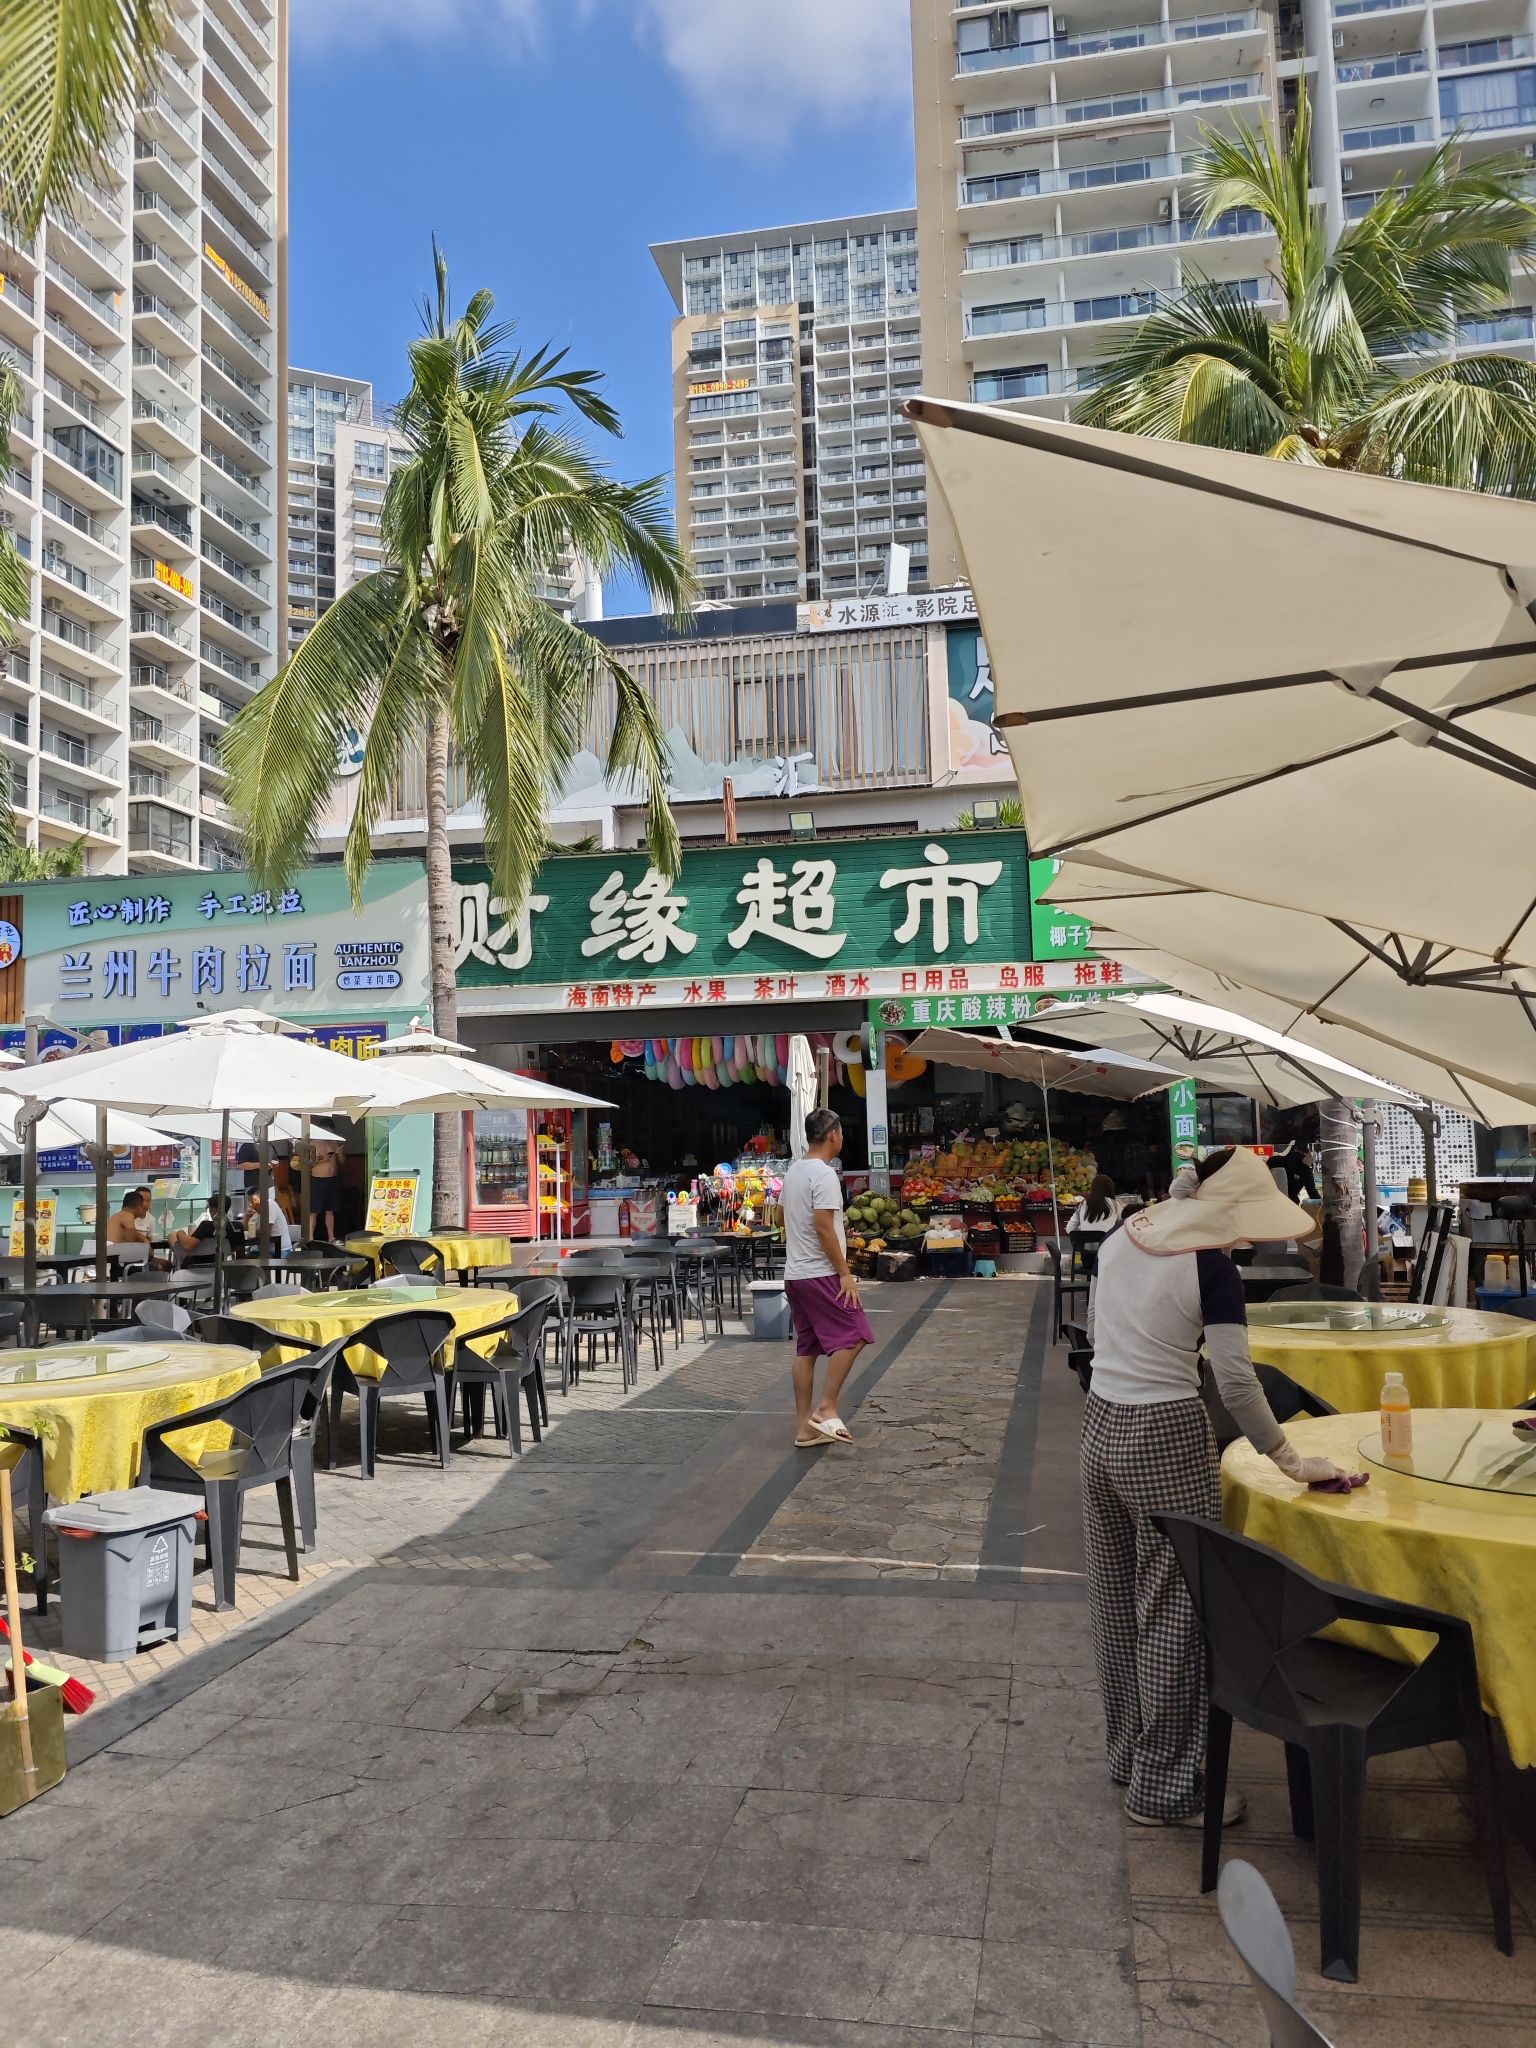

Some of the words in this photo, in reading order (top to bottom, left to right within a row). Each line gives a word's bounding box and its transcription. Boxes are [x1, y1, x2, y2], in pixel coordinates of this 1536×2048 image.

[67, 895, 173, 927] 匠心制作
[195, 888, 304, 921] 手工现拉
[452, 844, 1004, 970] 财缘超市
[334, 942, 402, 954] AUTHENTIC
[339, 955, 397, 967] LANZHOU
[58, 941, 318, 1000] 兰州牛肉拉面
[366, 974, 395, 986] 羊肉串
[567, 983, 657, 1008] 海南特产
[683, 981, 728, 1004] 水果
[753, 976, 799, 1001] 茶叶
[825, 972, 871, 996] 酒水
[901, 967, 969, 992] 日用品
[999, 965, 1045, 987] 岛服
[1075, 962, 1124, 984] 拖鞋
[911, 993, 1032, 1025] 重庆酸辣粉
[1174, 1083, 1196, 1139] 小面
